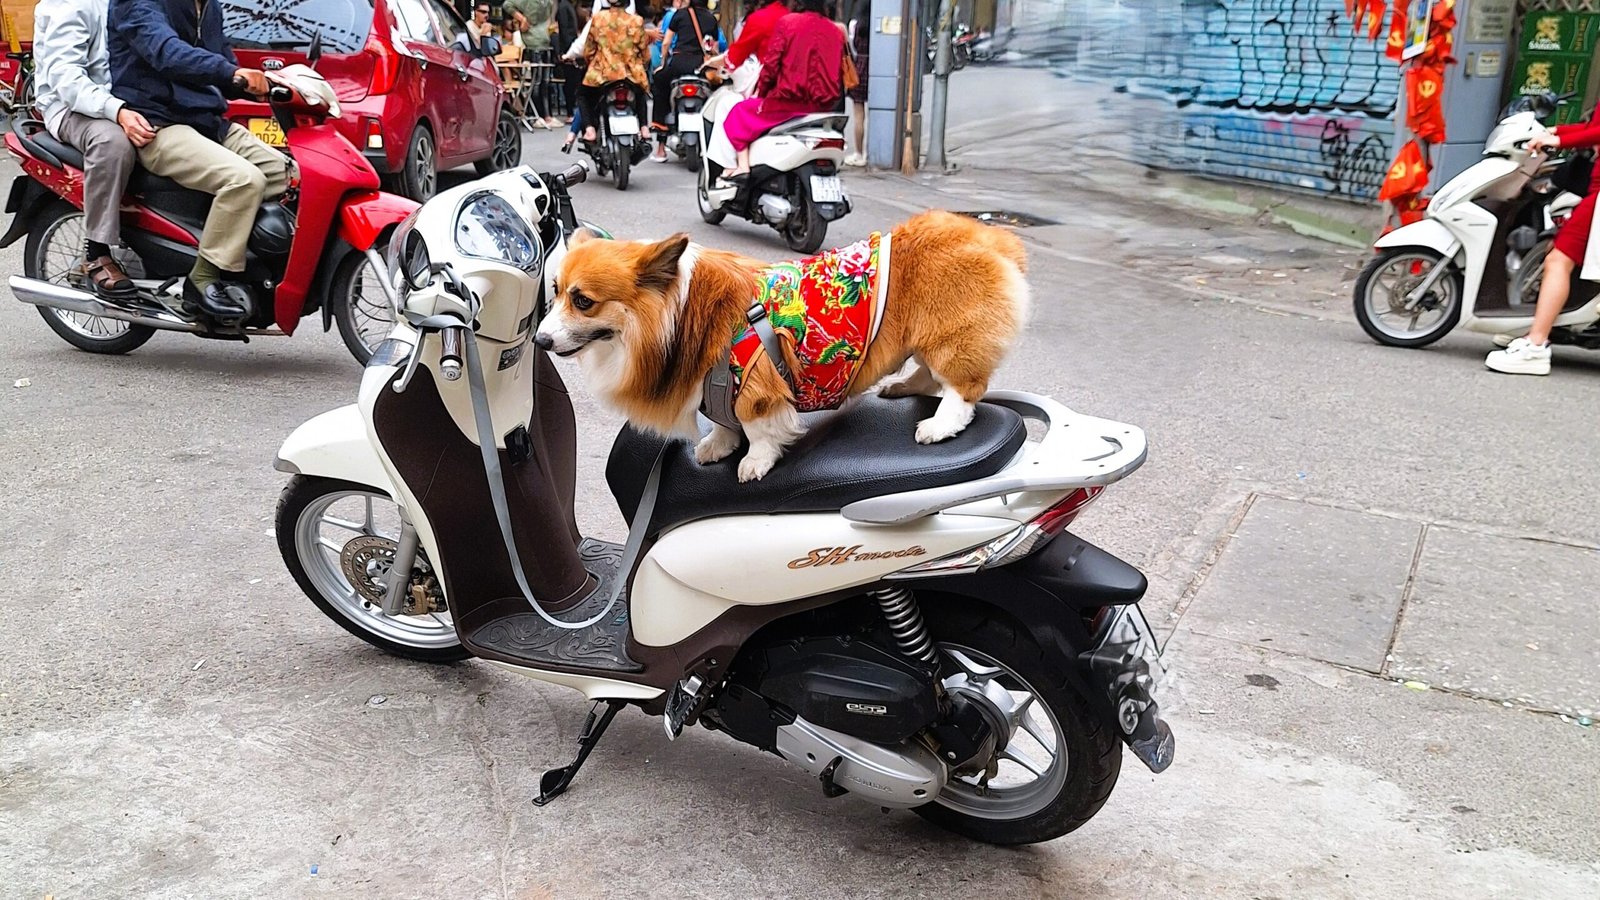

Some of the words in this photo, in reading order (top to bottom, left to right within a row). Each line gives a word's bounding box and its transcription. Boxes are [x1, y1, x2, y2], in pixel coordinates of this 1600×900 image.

[264, 120, 282, 132] 29
[787, 545, 863, 569] SH
[854, 545, 927, 561] mode
